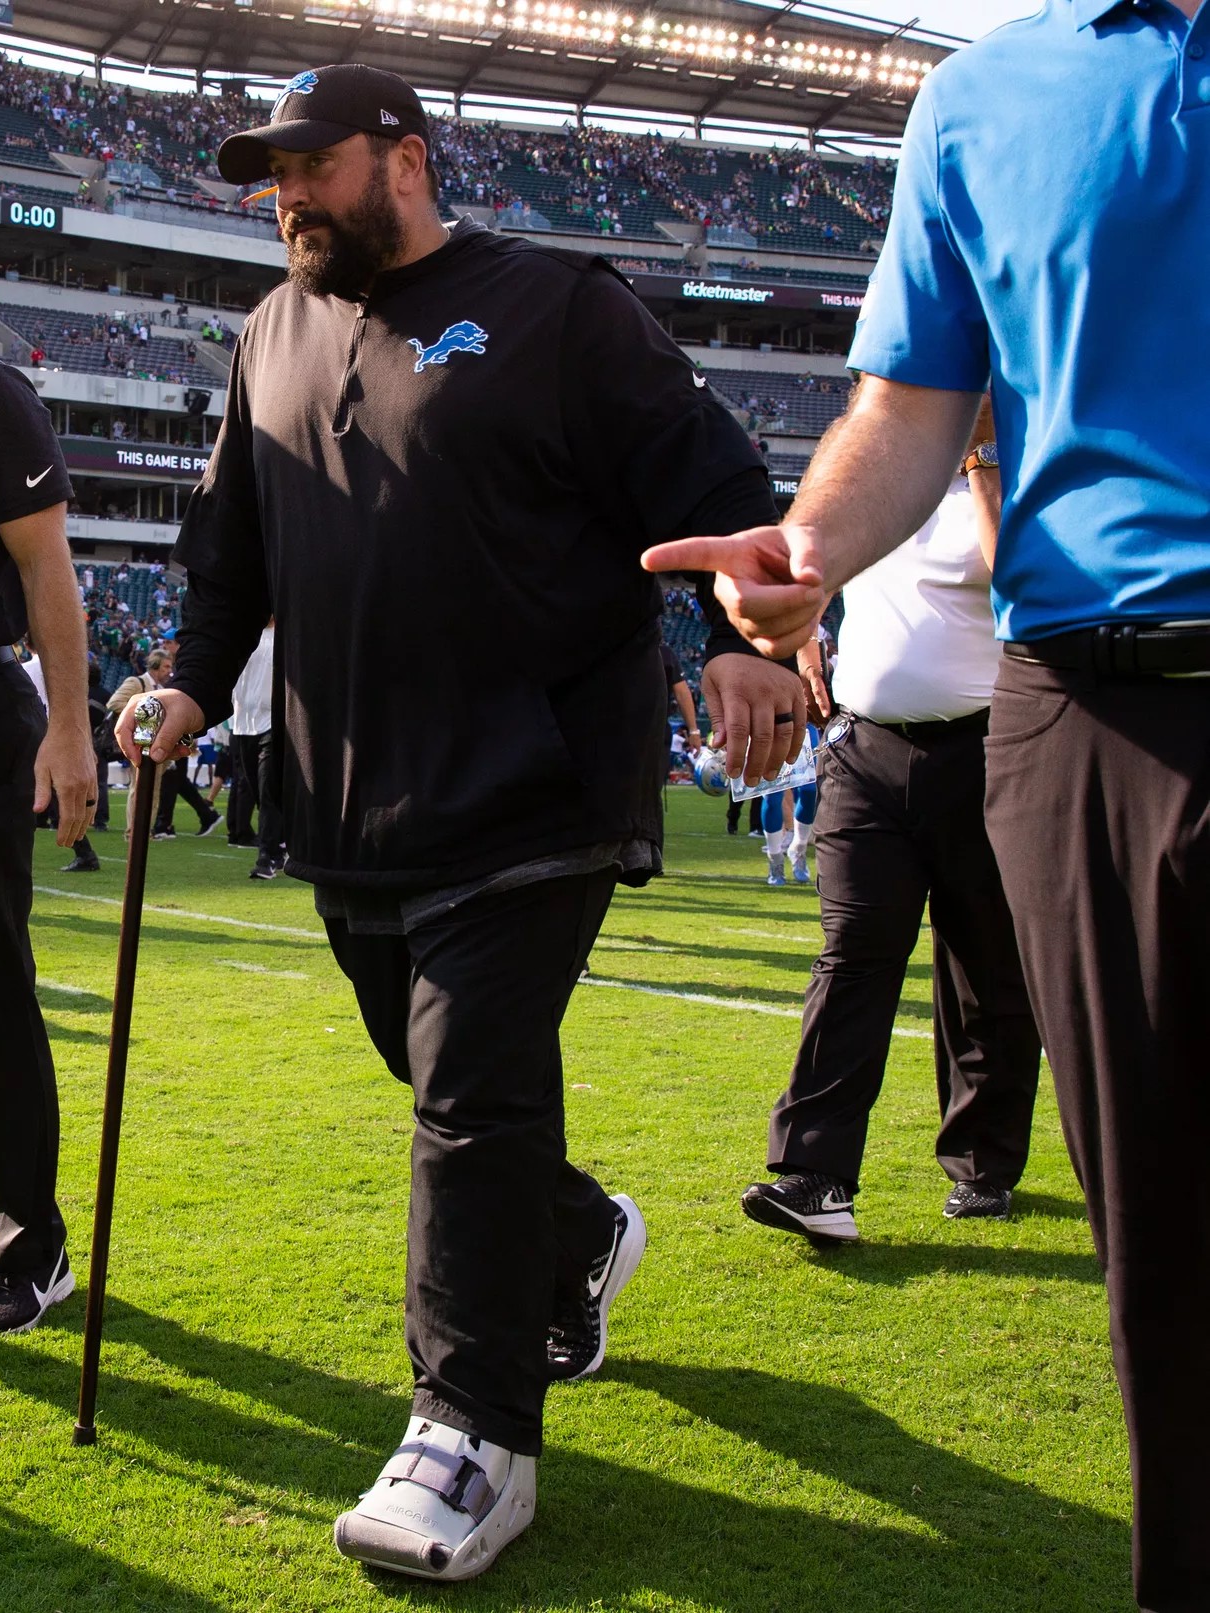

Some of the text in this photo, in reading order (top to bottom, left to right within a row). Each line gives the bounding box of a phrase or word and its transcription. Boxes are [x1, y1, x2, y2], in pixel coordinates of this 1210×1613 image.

[10, 202, 56, 229] 0:00
[820, 293, 865, 307] THIS GAM
[116, 450, 211, 472] THIS GAME IS PR
[772, 480, 799, 494] THIS
